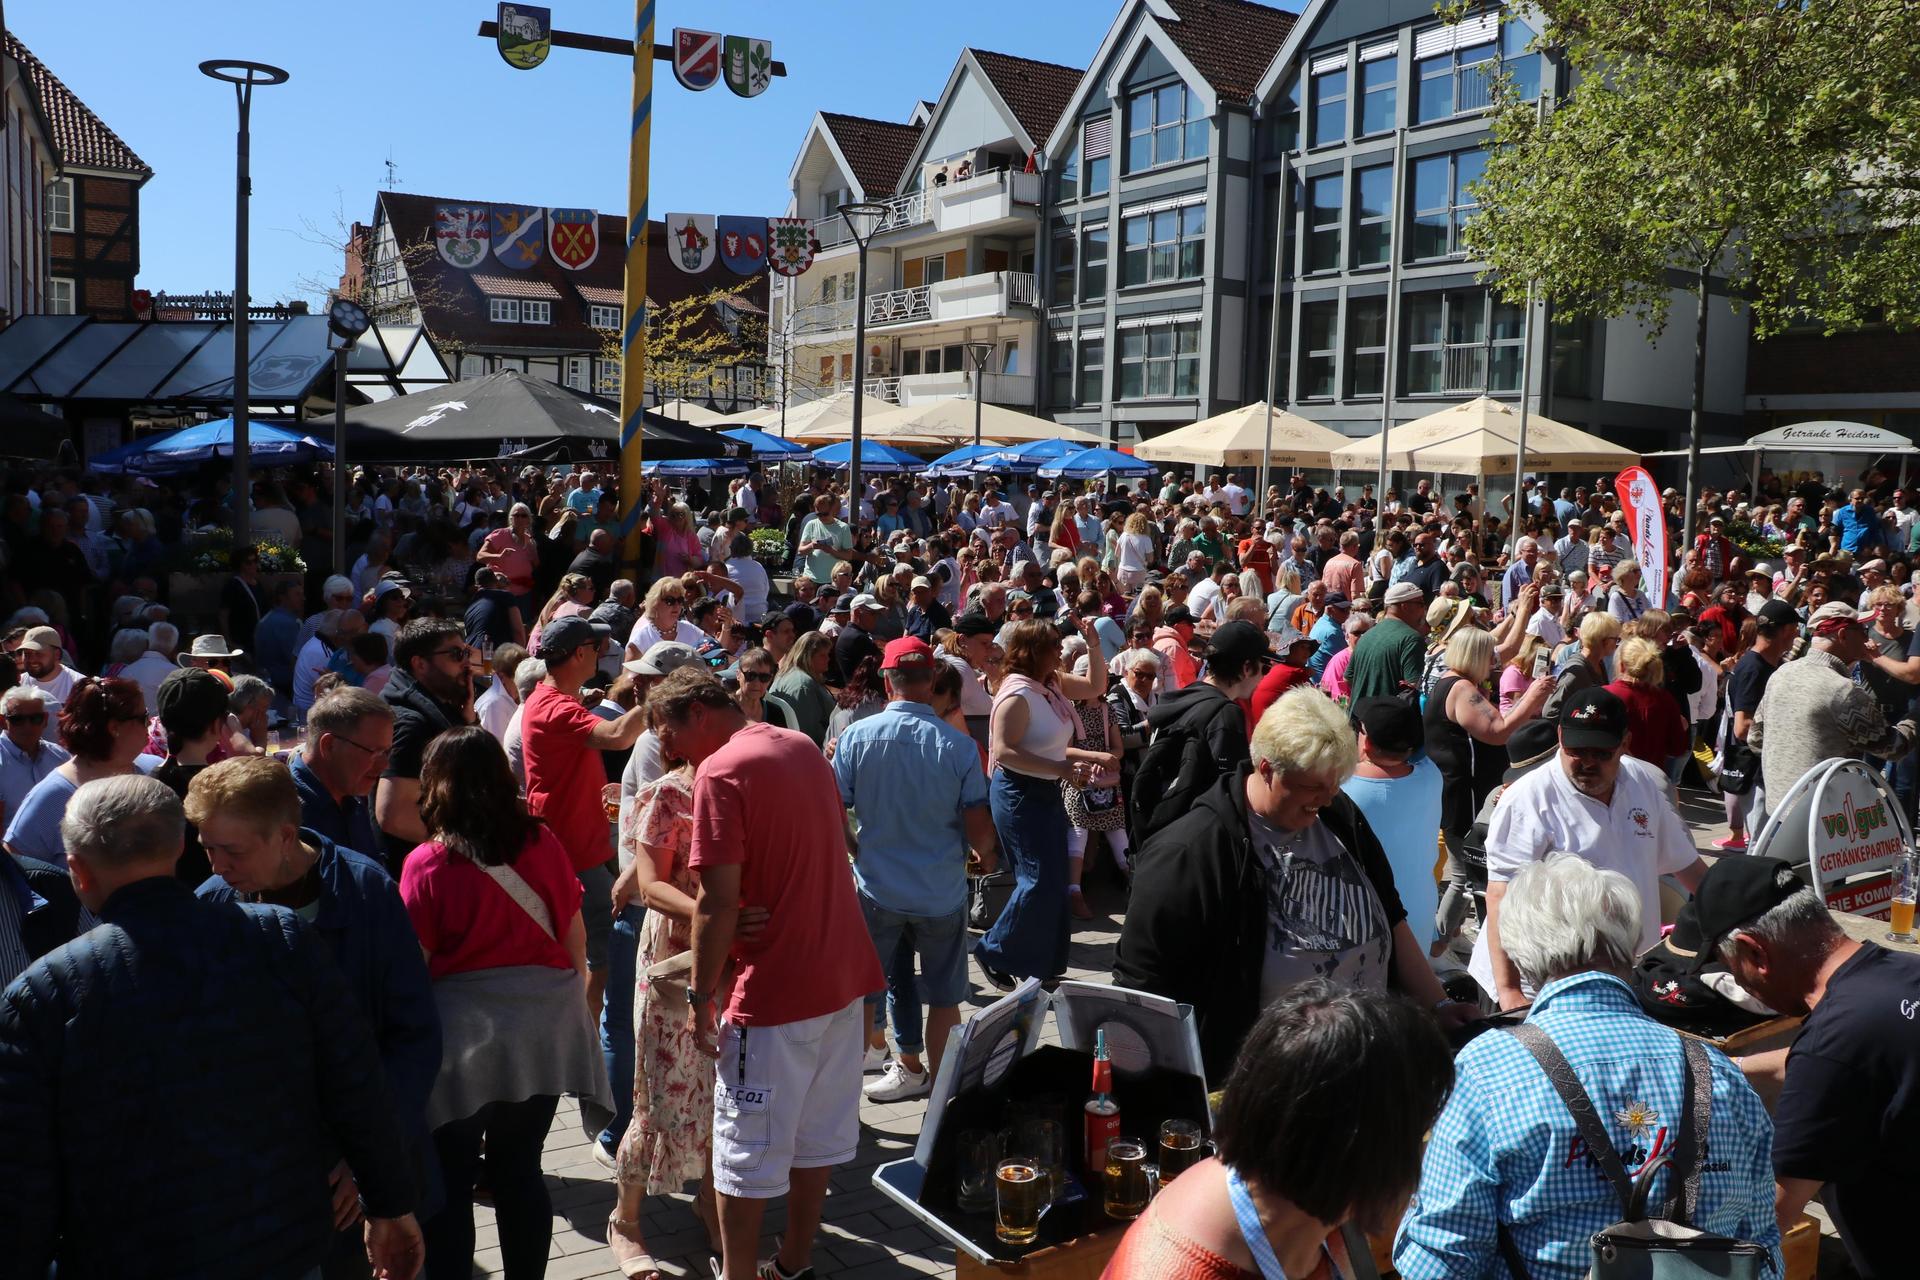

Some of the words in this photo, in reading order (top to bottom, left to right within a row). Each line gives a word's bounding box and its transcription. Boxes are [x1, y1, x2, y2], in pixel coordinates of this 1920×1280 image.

[1782, 427, 1832, 440] Getränke
[1835, 428, 1881, 439] Heidorn
[1821, 791, 1888, 844] vollgut
[1819, 837, 1901, 873] GETRÄNKEPARTNER
[1829, 896, 1852, 911] SIE
